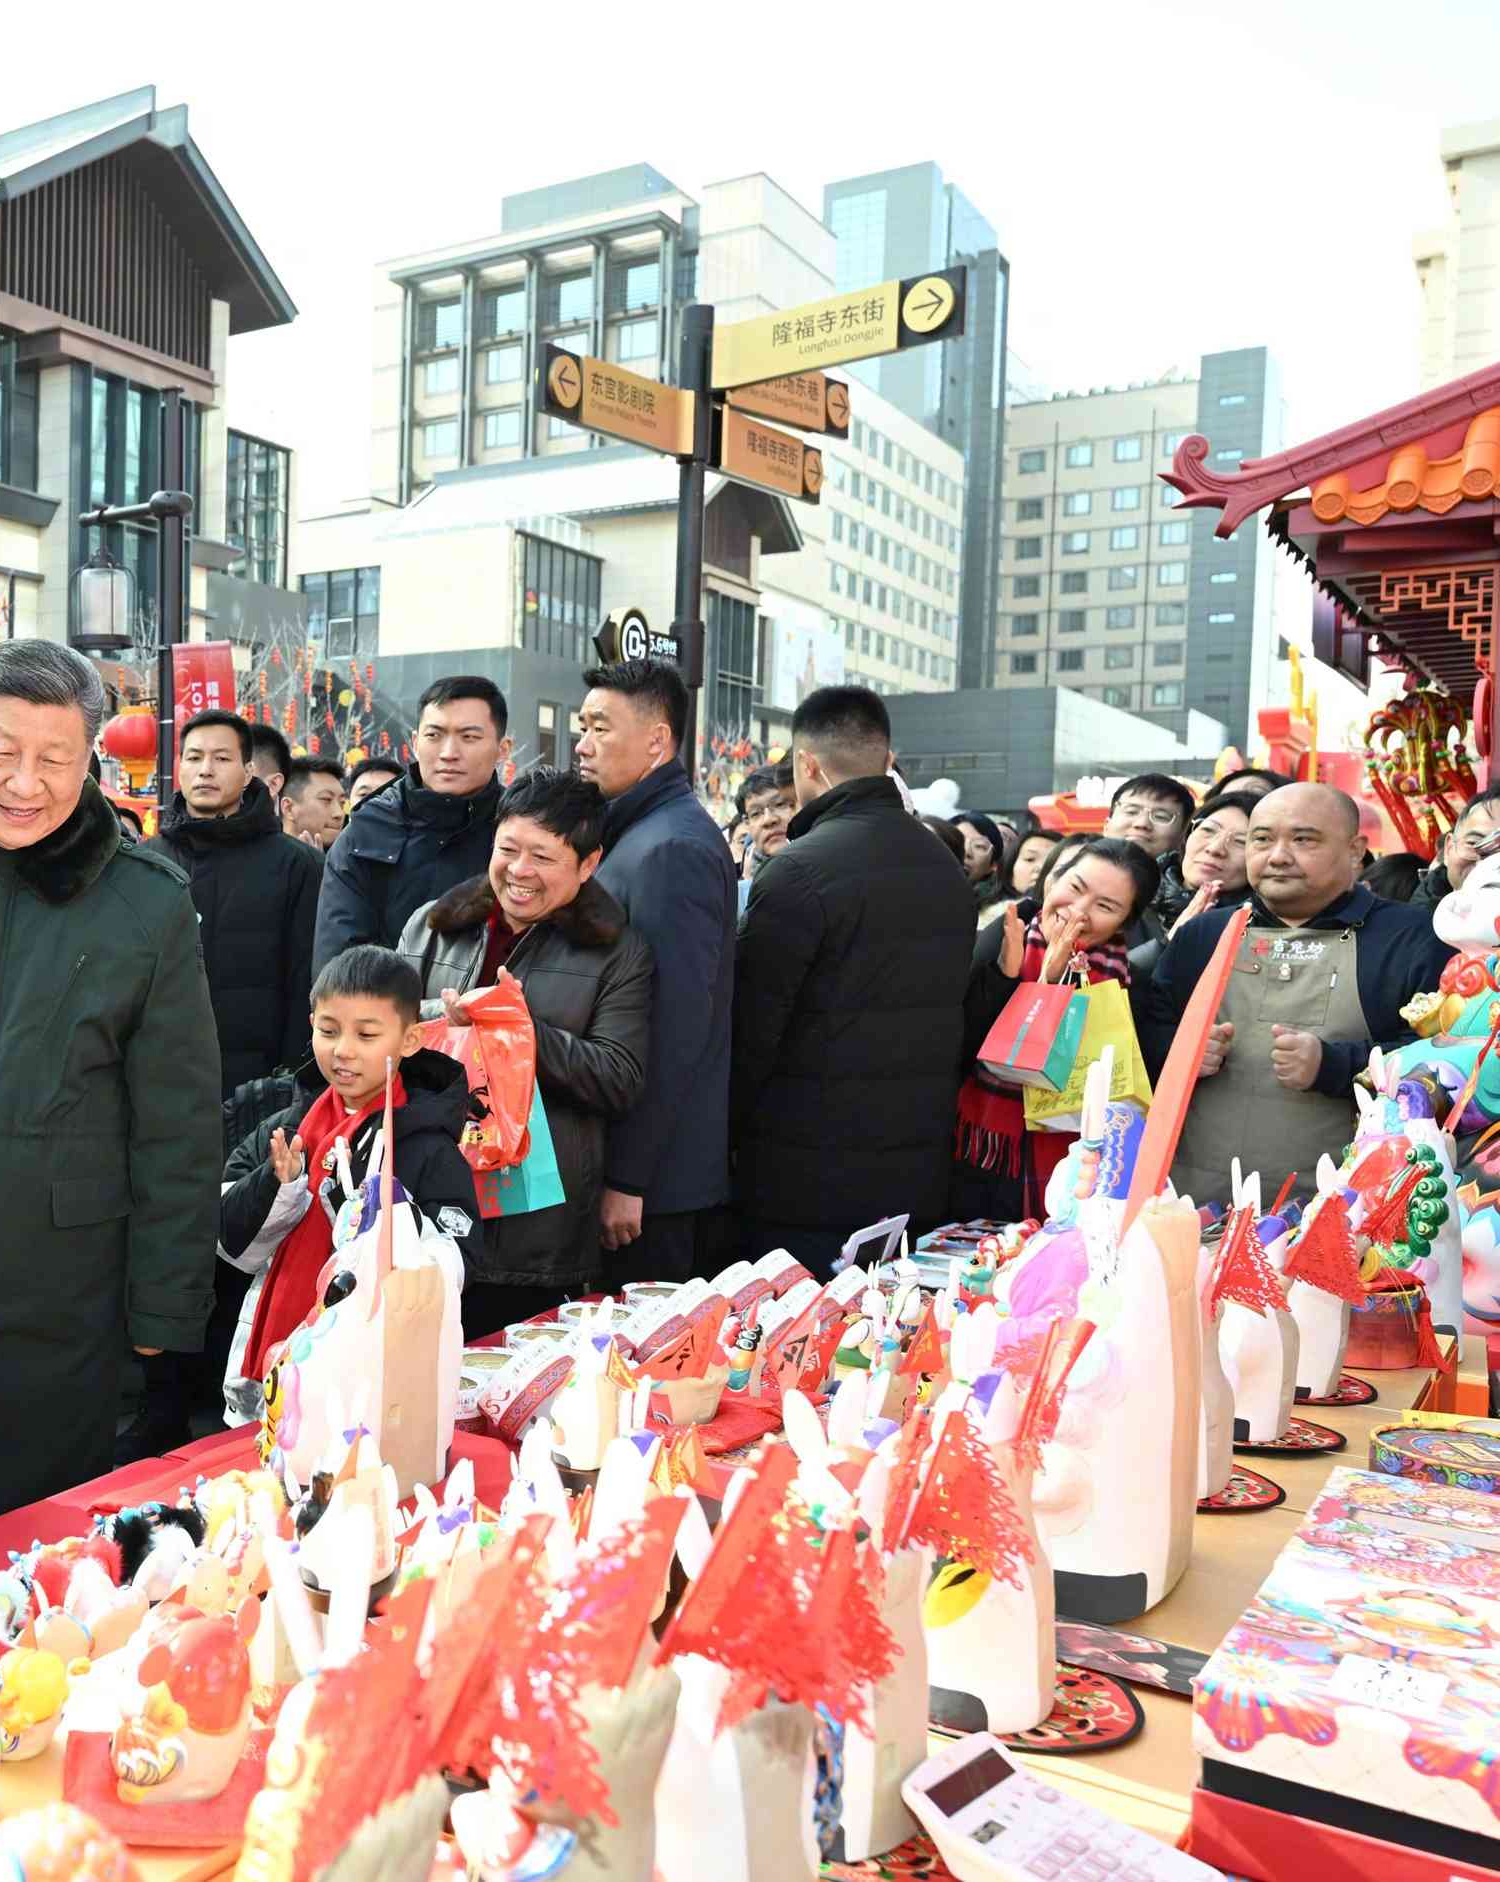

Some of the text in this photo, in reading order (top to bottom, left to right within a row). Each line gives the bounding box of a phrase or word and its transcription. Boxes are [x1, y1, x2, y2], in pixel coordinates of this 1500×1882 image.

[772, 297, 885, 348] 隆福寺东街
[844, 326, 885, 345] Dongjie
